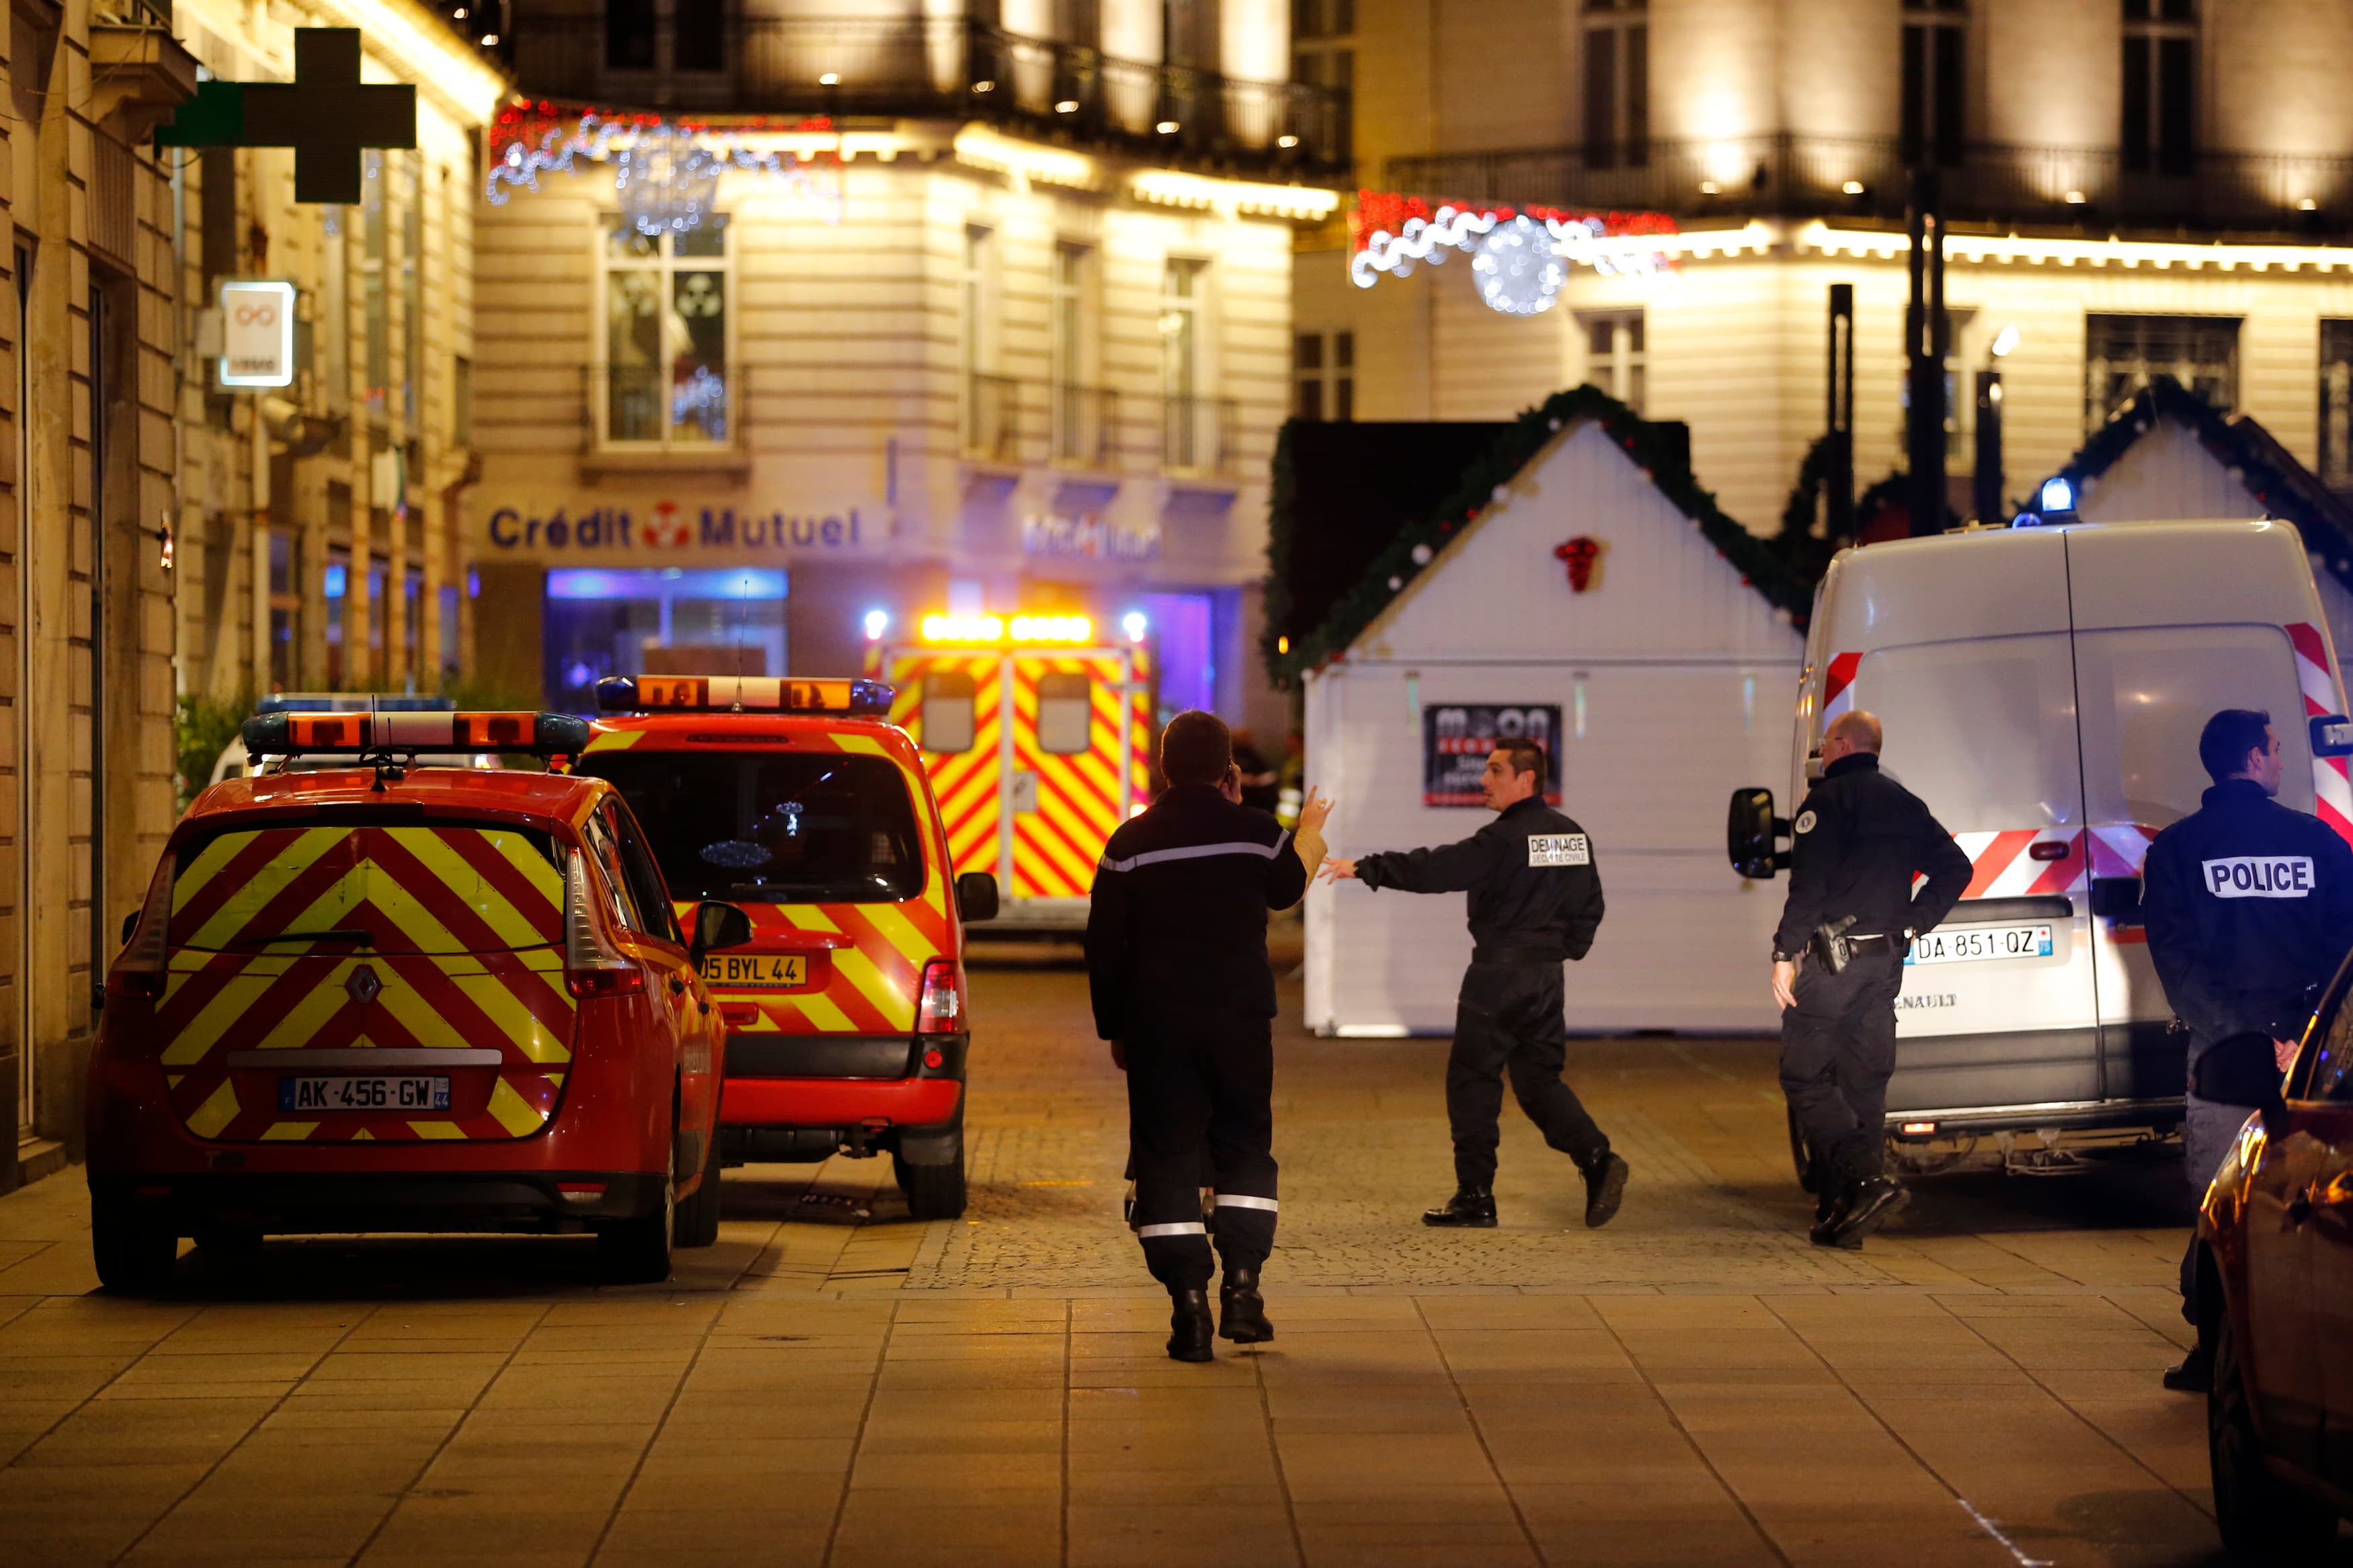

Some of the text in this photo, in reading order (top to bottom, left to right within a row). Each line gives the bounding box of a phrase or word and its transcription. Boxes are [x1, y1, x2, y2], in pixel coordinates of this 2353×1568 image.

[489, 505, 860, 548] Crédit Mutuel
[2210, 862, 2309, 893] POLICE
[727, 958, 765, 980] BYL
[772, 958, 797, 980] 44
[1895, 994, 1958, 1009] ENAULT
[284, 1097, 290, 1105] F
[434, 1094, 449, 1106] 44
